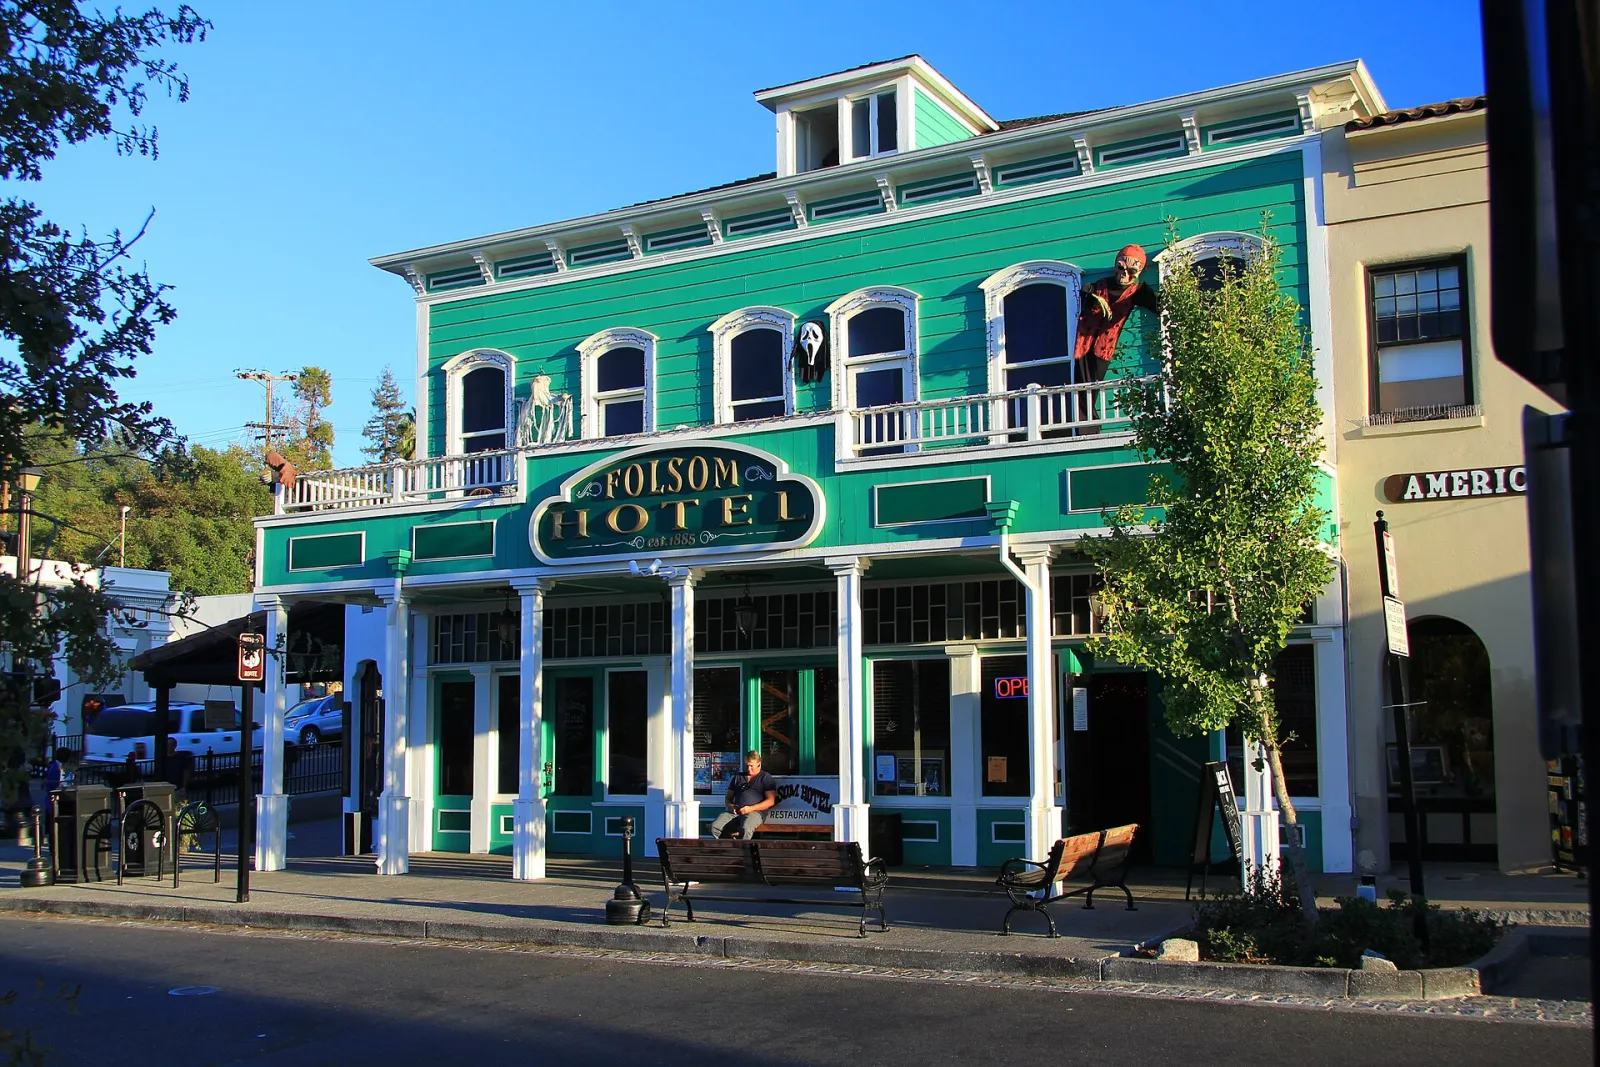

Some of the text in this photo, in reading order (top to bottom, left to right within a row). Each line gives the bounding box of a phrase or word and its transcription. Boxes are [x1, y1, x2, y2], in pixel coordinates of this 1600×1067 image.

[605, 456, 740, 499] FOLSOM
[550, 490, 807, 540] HOTEL
[669, 532, 696, 546] 1885
[776, 783, 832, 814] SOM HOTEL
[769, 810, 819, 820] RESTAURANT
